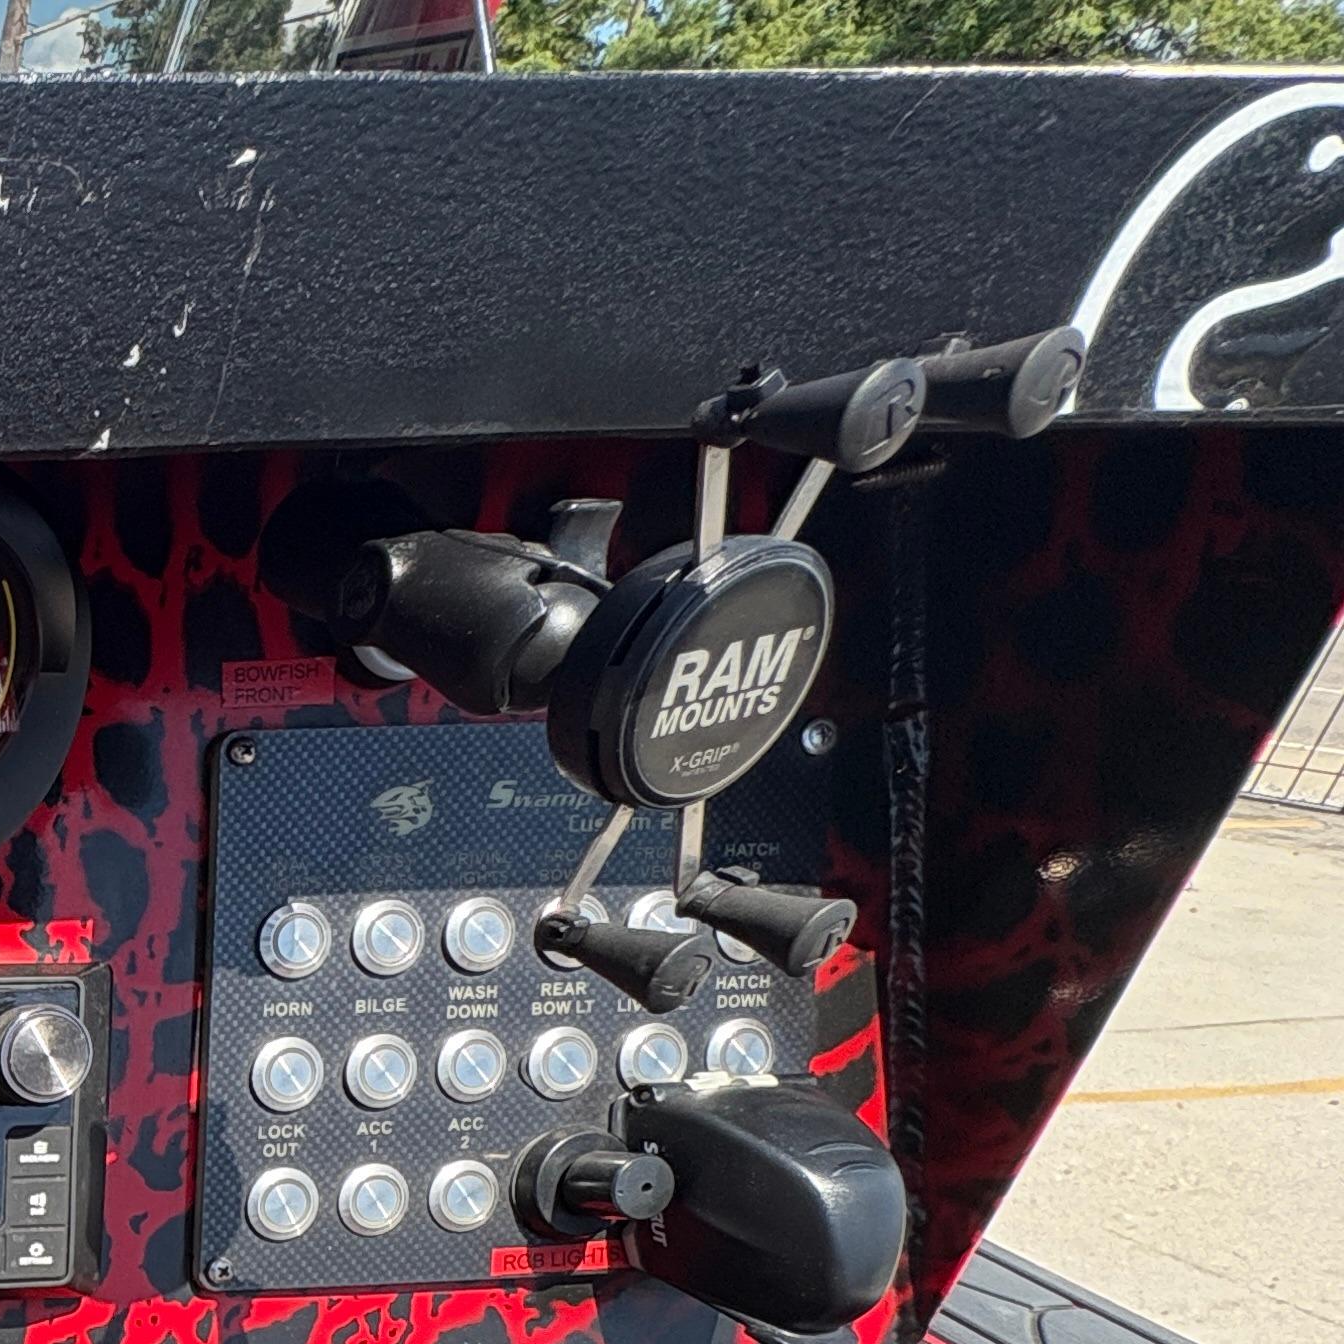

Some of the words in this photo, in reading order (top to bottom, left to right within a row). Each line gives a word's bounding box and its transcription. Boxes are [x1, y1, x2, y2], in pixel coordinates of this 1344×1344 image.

[233, 662, 319, 683] BOWFISH
[661, 627, 803, 709] RAM
[234, 686, 302, 704] FRONT
[650, 685, 782, 739] MOUNTS
[669, 744, 732, 775] X-GRIP
[486, 779, 593, 809] Swamp
[568, 813, 653, 834] Cusm
[724, 842, 780, 857] HATCH
[539, 981, 587, 997] REAR
[714, 974, 771, 990] HATCH
[447, 984, 499, 1000] WASH
[716, 992, 768, 1008] DOWN
[263, 1001, 313, 1017] HORN
[354, 997, 408, 1014] BILGE
[445, 1003, 499, 1019] DOWN
[531, 1001, 571, 1016] BOW
[575, 999, 596, 1014] LT
[257, 1124, 306, 1140] LOCK
[355, 1120, 394, 1136] ACC
[447, 1117, 485, 1132] ACC
[262, 1142, 300, 1158] OUT
[369, 1139, 377, 1153] 1
[460, 1135, 470, 1149] 2
[551, 1247, 620, 1268] LIGHTS
